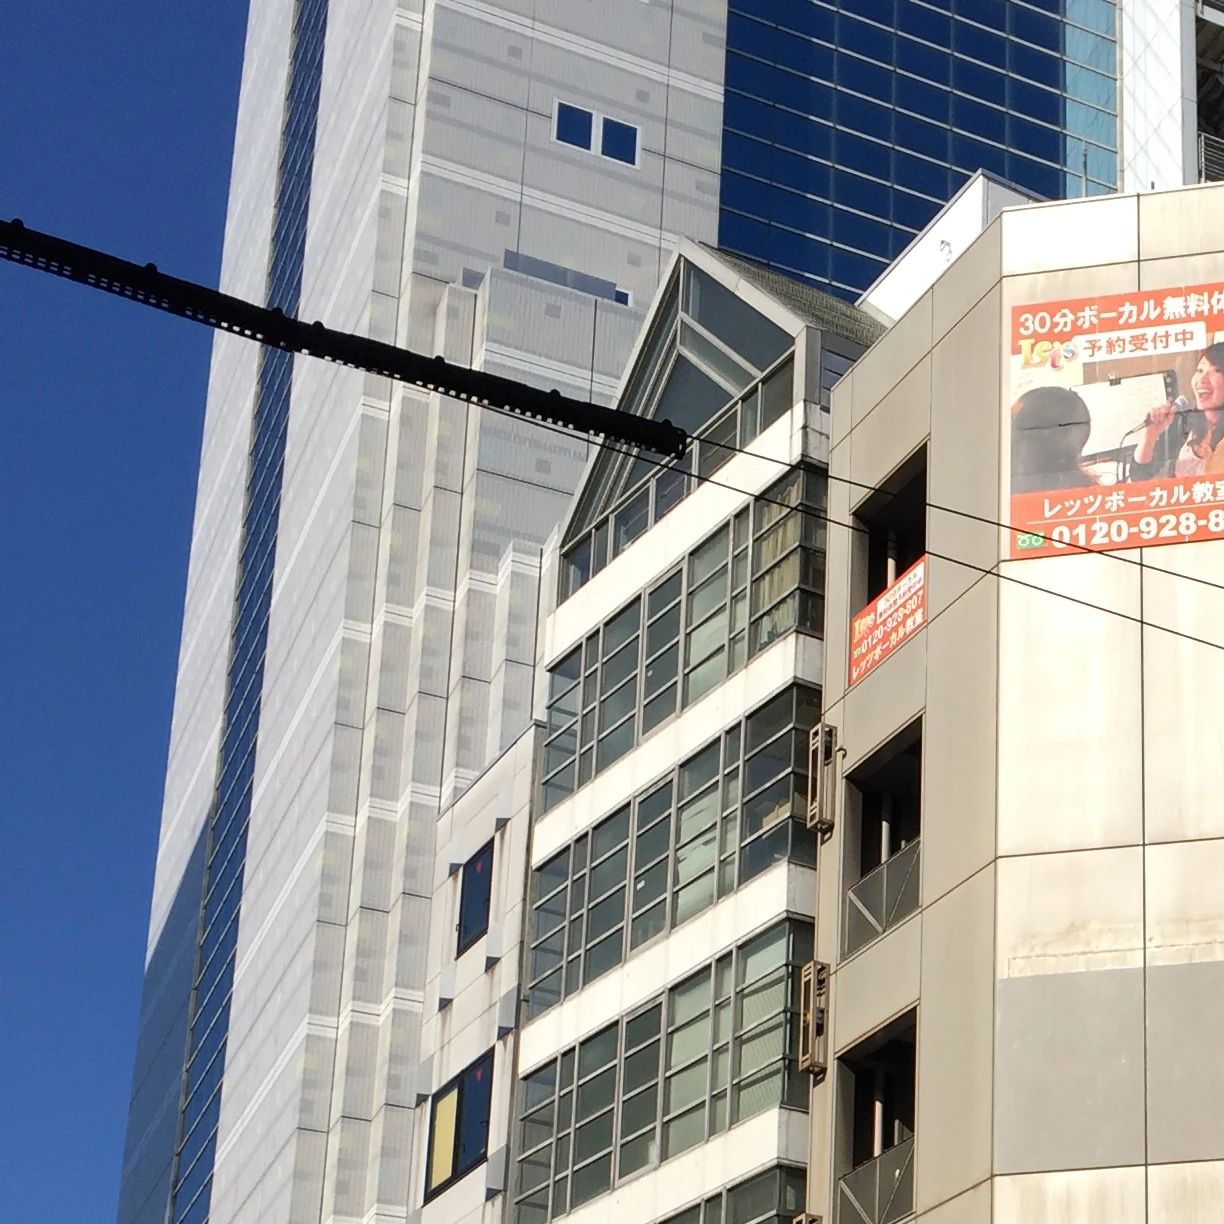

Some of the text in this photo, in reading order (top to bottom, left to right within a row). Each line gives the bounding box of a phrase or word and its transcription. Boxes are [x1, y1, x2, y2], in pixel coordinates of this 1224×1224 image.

[1084, 328, 1195, 358] 予約受付中
